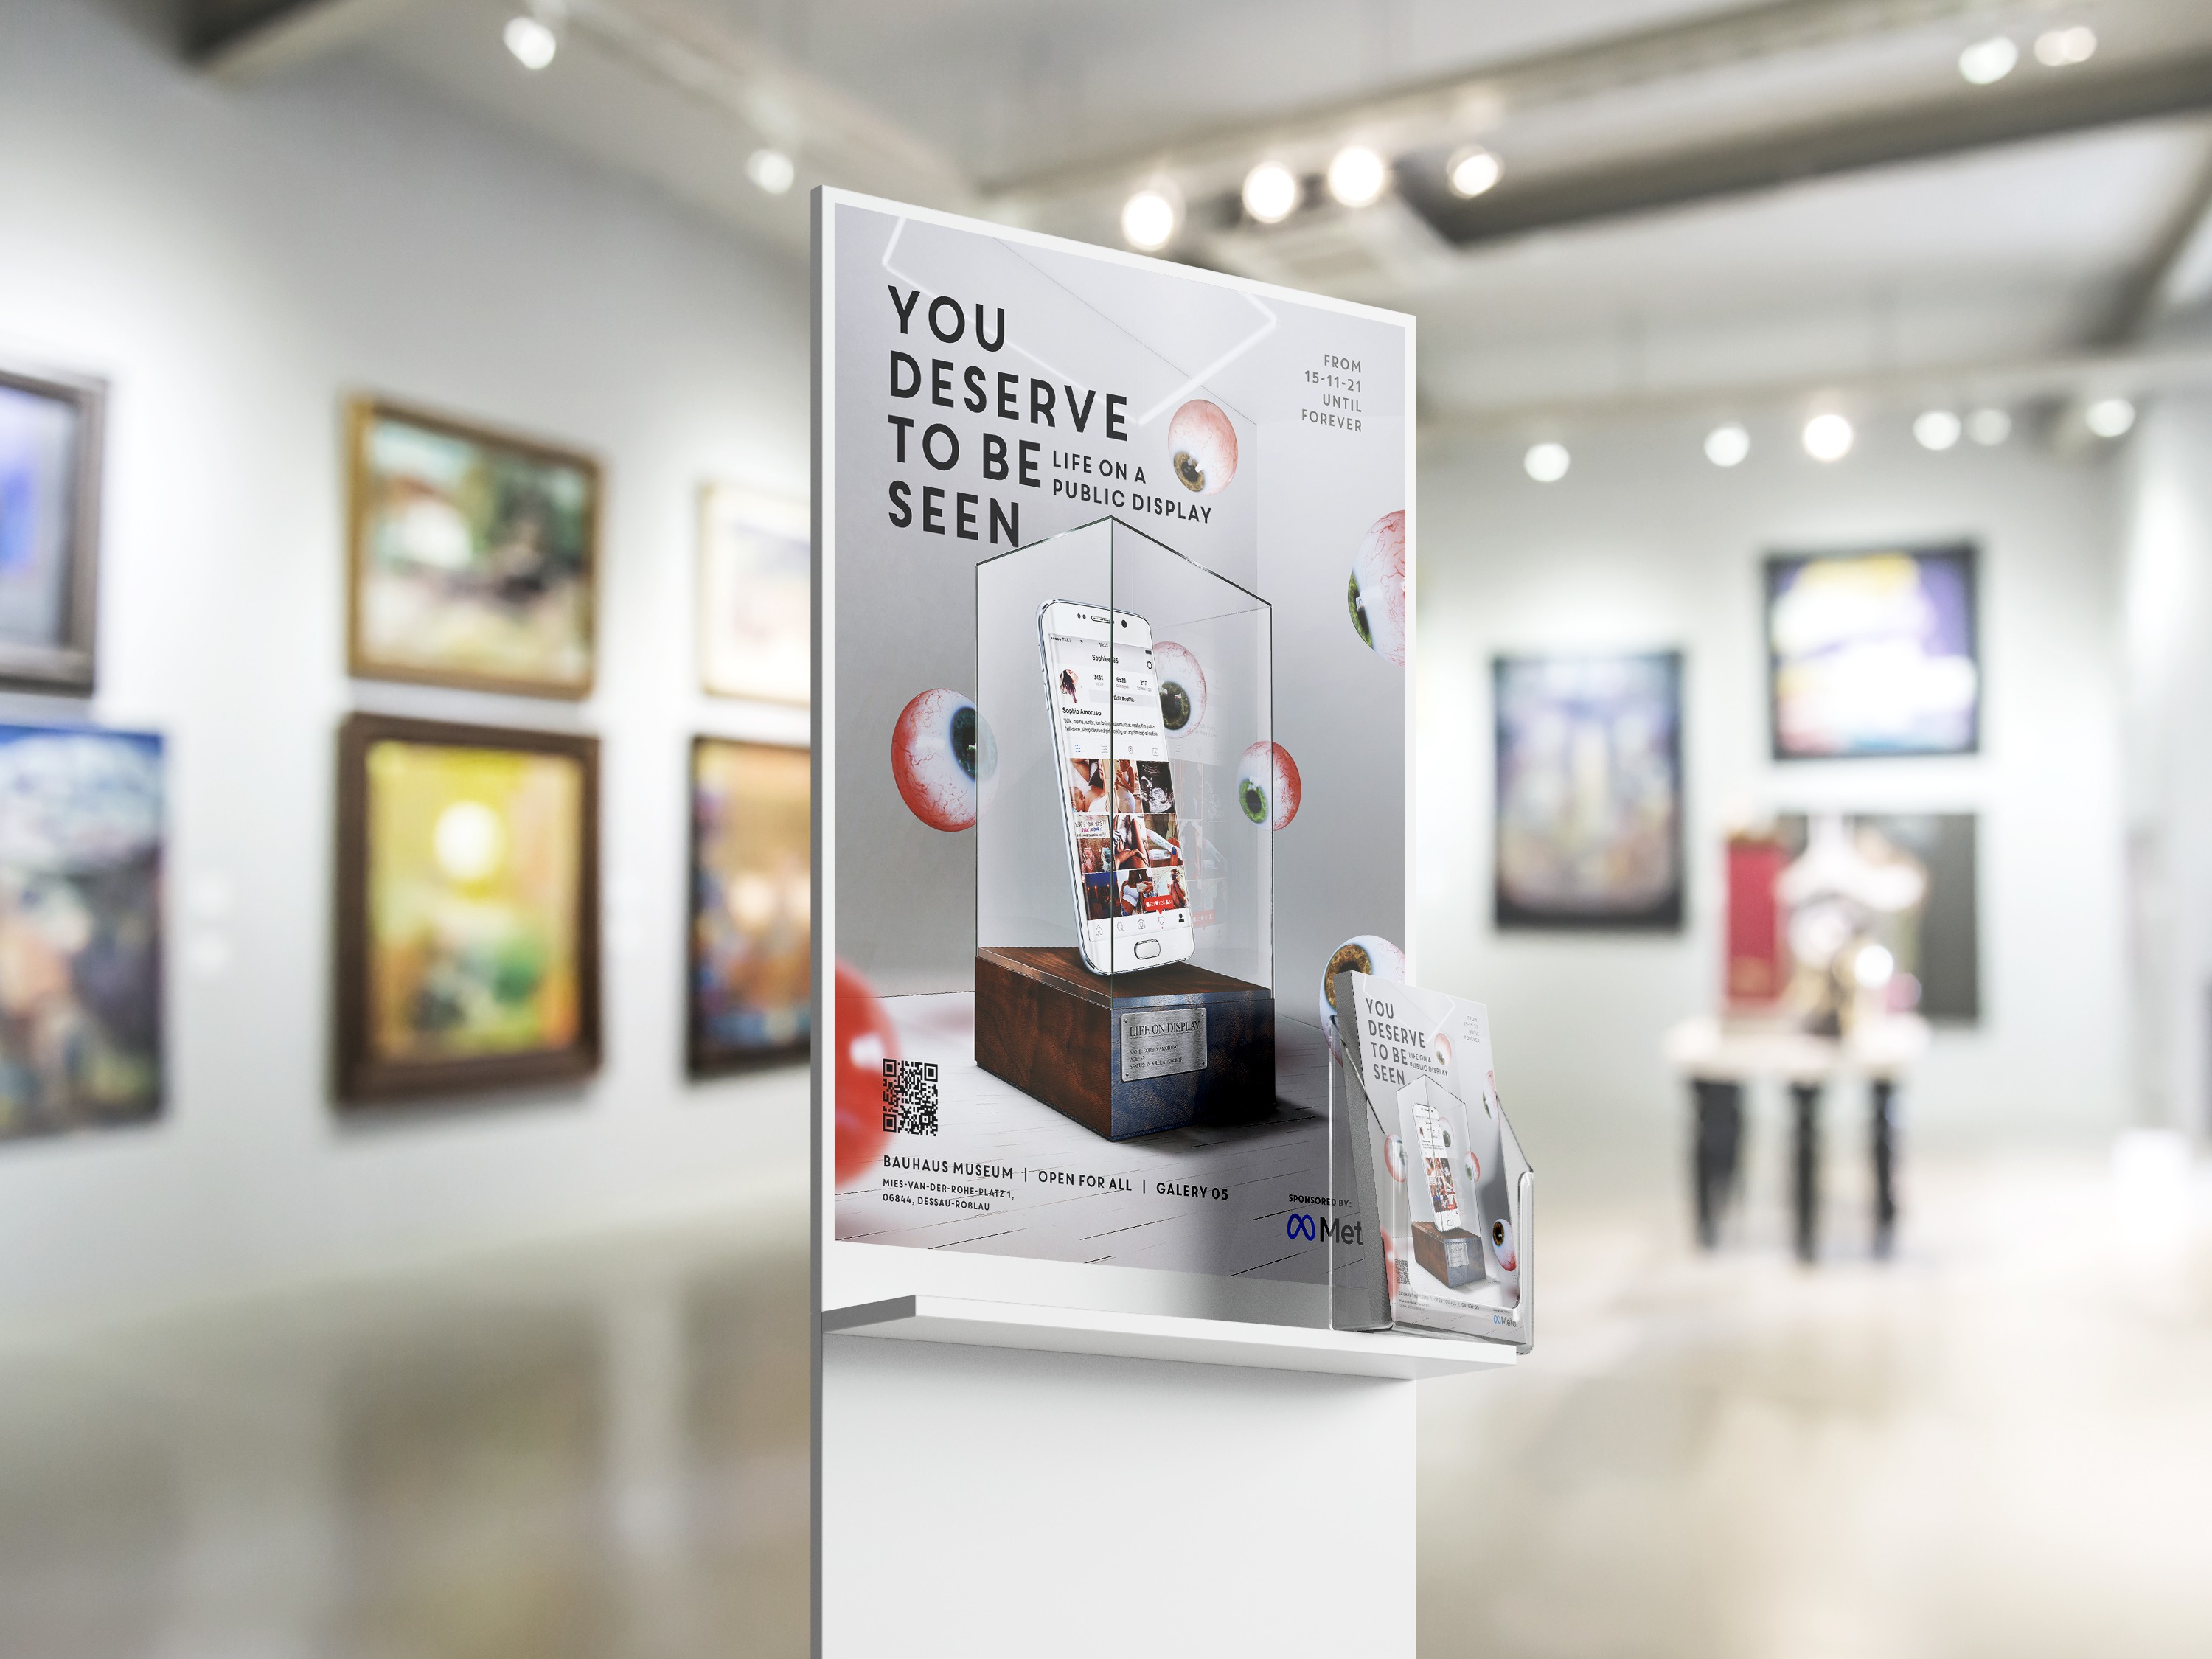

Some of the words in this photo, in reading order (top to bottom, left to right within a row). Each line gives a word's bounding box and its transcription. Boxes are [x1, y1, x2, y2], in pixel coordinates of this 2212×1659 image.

[887, 285, 1006, 352] YOU
[1324, 354, 1361, 373] FROM
[1304, 370, 1361, 393] 15-11-21
[888, 350, 1128, 441] DESERVE
[1323, 393, 1362, 413] UNTIL
[1301, 408, 1362, 432] FOREVER
[888, 414, 960, 471] TO
[983, 432, 1041, 489] BE
[1053, 450, 1092, 474] LIFE
[1099, 459, 1127, 480] ON
[1134, 466, 1147, 484] A
[1053, 479, 1125, 508] PUBLIC
[1132, 493, 1212, 524] DISPLAY
[888, 480, 1019, 549] SEEN
[1062, 707, 1079, 715] Sophia
[1365, 998, 1394, 1019] YOU
[1130, 1025, 1150, 1037] LIFE
[1152, 1023, 1165, 1034] ON
[1167, 1020, 1200, 1033] DISPLAY
[1368, 1020, 1426, 1048] DESERVE
[1370, 1041, 1388, 1060] TO
[1392, 1046, 1408, 1065] BE
[1408, 1052, 1419, 1060] LIFE
[1374, 1063, 1405, 1086] SEEN
[1409, 1061, 1428, 1071] PUBLIC
[1428, 1066, 1448, 1077] DISPLAY
[883, 1155, 948, 1173] BAUHAUS
[953, 1162, 1012, 1179] MUSEUM
[1038, 1171, 1074, 1186] OPEN
[1079, 1175, 1105, 1189] FOR
[1109, 1178, 1132, 1191] ALL
[1156, 1182, 1208, 1198] GALERY
[1211, 1188, 1228, 1200] 05
[883, 1178, 1004, 1198] MIES-VAN-DER-ROHE-PLATZ
[1006, 1190, 1015, 1200] 1,
[883, 1193, 915, 1206] 06844,
[1288, 1194, 1336, 1206] SPONSORED
[1339, 1199, 1352, 1208] BY:
[1320, 1217, 1363, 1246] Met
